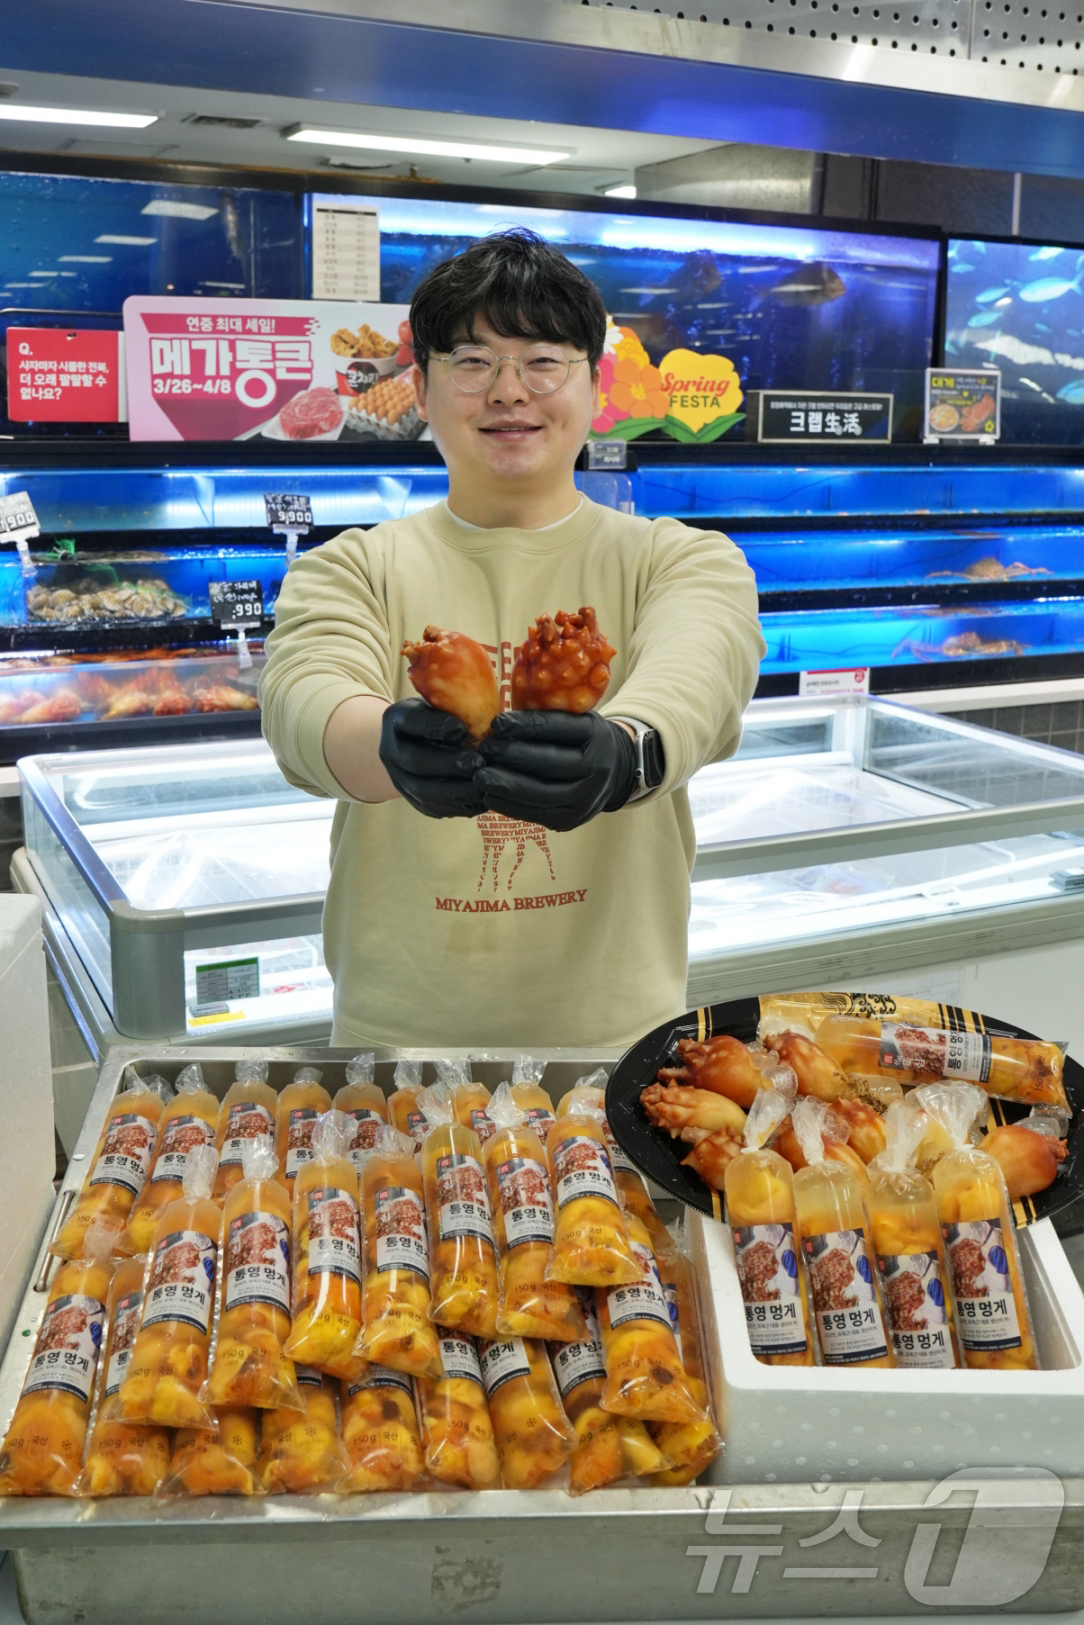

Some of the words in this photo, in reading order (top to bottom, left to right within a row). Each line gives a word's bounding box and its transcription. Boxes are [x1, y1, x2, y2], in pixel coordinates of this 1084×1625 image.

[186, 316, 213, 332] 연중
[216, 317, 242, 332] 최대
[245, 318, 276, 333] 세일!
[18, 341, 34, 356] Q.
[19, 373, 31, 386] 더
[33, 373, 57, 387] 오래
[94, 375, 107, 387] 수
[150, 338, 313, 408] 메가통큰
[153, 378, 231, 394] 3/26~4/8
[660, 372, 731, 397] Spring
[20, 387, 63, 401] 없나요?
[669, 395, 721, 409] FESTA
[435, 897, 511, 912] MIYAJIMA
[513, 889, 588, 911] BREWERY
[104, 1155, 129, 1166] 통영
[563, 1172, 585, 1187] 통영
[589, 1172, 612, 1188] 멍게
[449, 1203, 474, 1215] 통영
[512, 1208, 536, 1222] 통영
[387, 1236, 411, 1248] 통영
[235, 1266, 260, 1282] 통영
[264, 1267, 286, 1286] 멍게
[152, 1285, 177, 1302] 통영
[181, 1286, 205, 1305] 멍게
[615, 1287, 641, 1302] 통영
[770, 1302, 797, 1321] 멍게
[979, 1298, 1007, 1317] 멍게
[822, 1312, 846, 1331] 통영
[849, 1308, 875, 1327] 멍게
[917, 1330, 944, 1349] 멍게
[442, 1341, 469, 1355] 통영
[558, 1344, 582, 1366] 통영
[34, 1351, 60, 1369] 통영
[64, 1352, 90, 1372] 멍게
